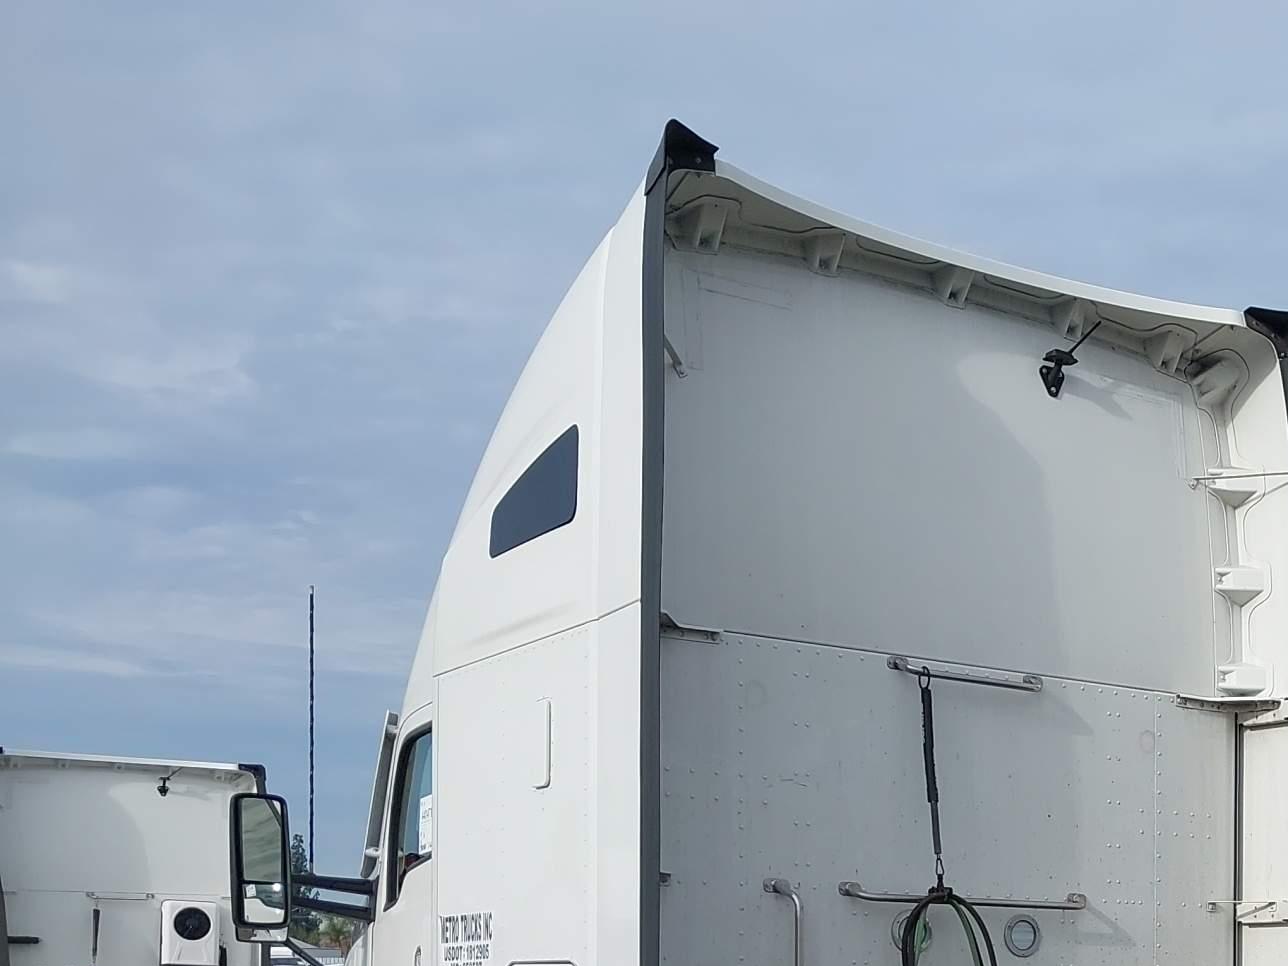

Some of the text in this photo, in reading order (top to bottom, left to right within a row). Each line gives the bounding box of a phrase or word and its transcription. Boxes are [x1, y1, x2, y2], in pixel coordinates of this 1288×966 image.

[440, 911, 493, 943] METRO TRUCKS INC
